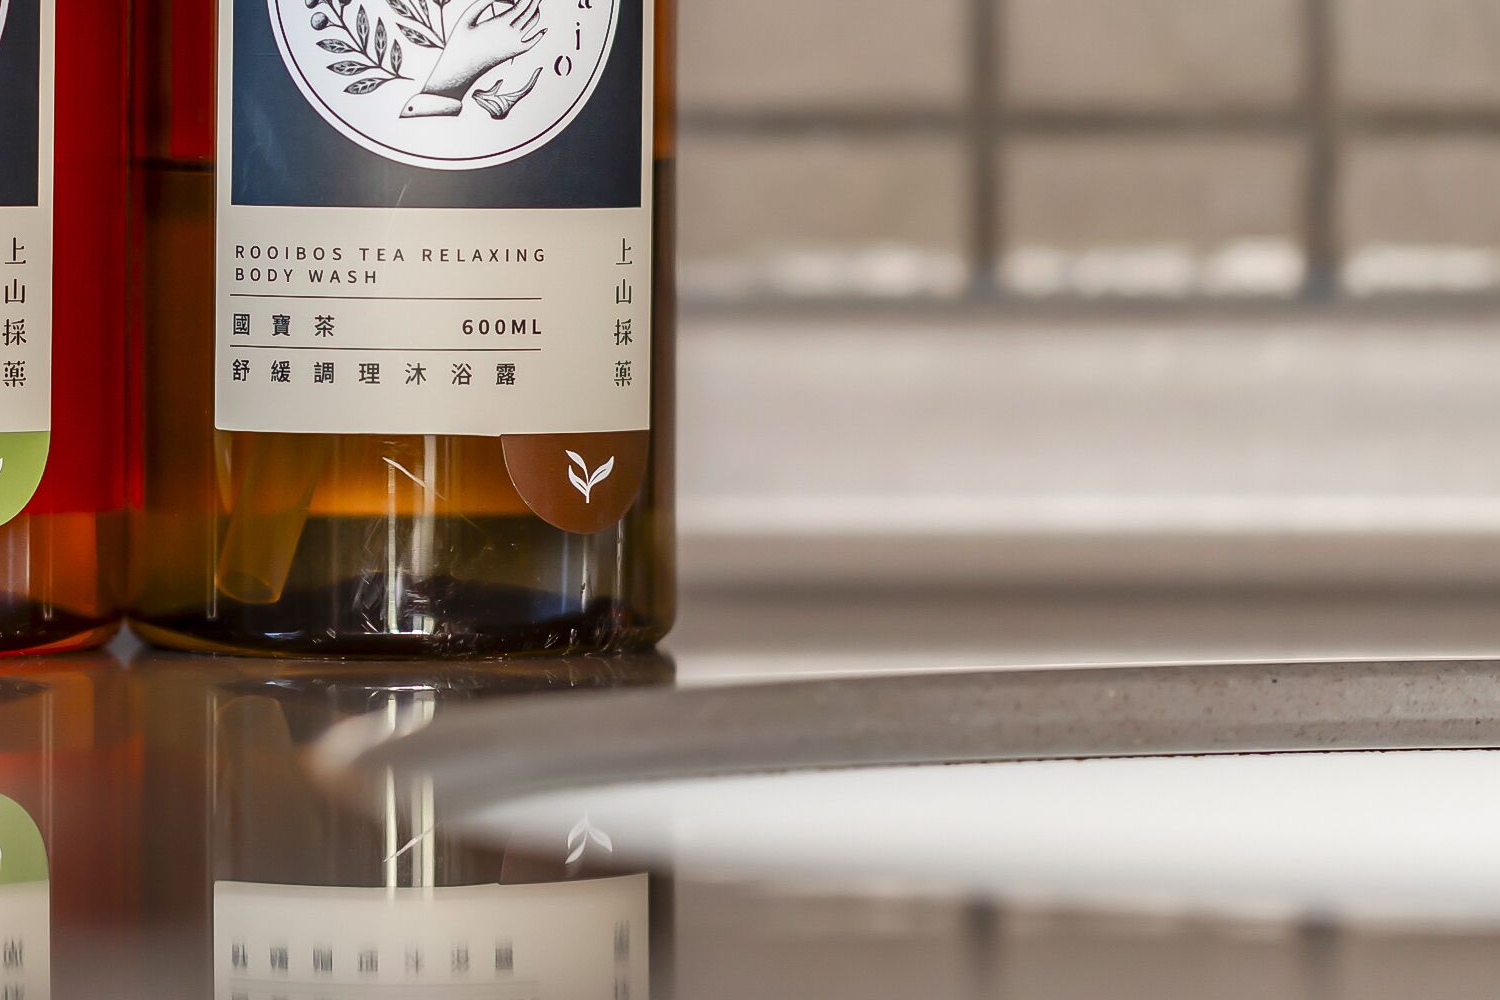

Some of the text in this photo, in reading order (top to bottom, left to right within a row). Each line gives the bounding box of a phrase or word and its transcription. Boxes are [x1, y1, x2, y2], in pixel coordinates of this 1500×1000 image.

[235, 244, 545, 263] ROOIBOS TEA RELAXING
[235, 267, 376, 284] BODY WASH
[232, 312, 336, 338] 國寶茶
[461, 318, 542, 336] 600ML
[231, 358, 517, 386] 舒緩調理沐浴露
